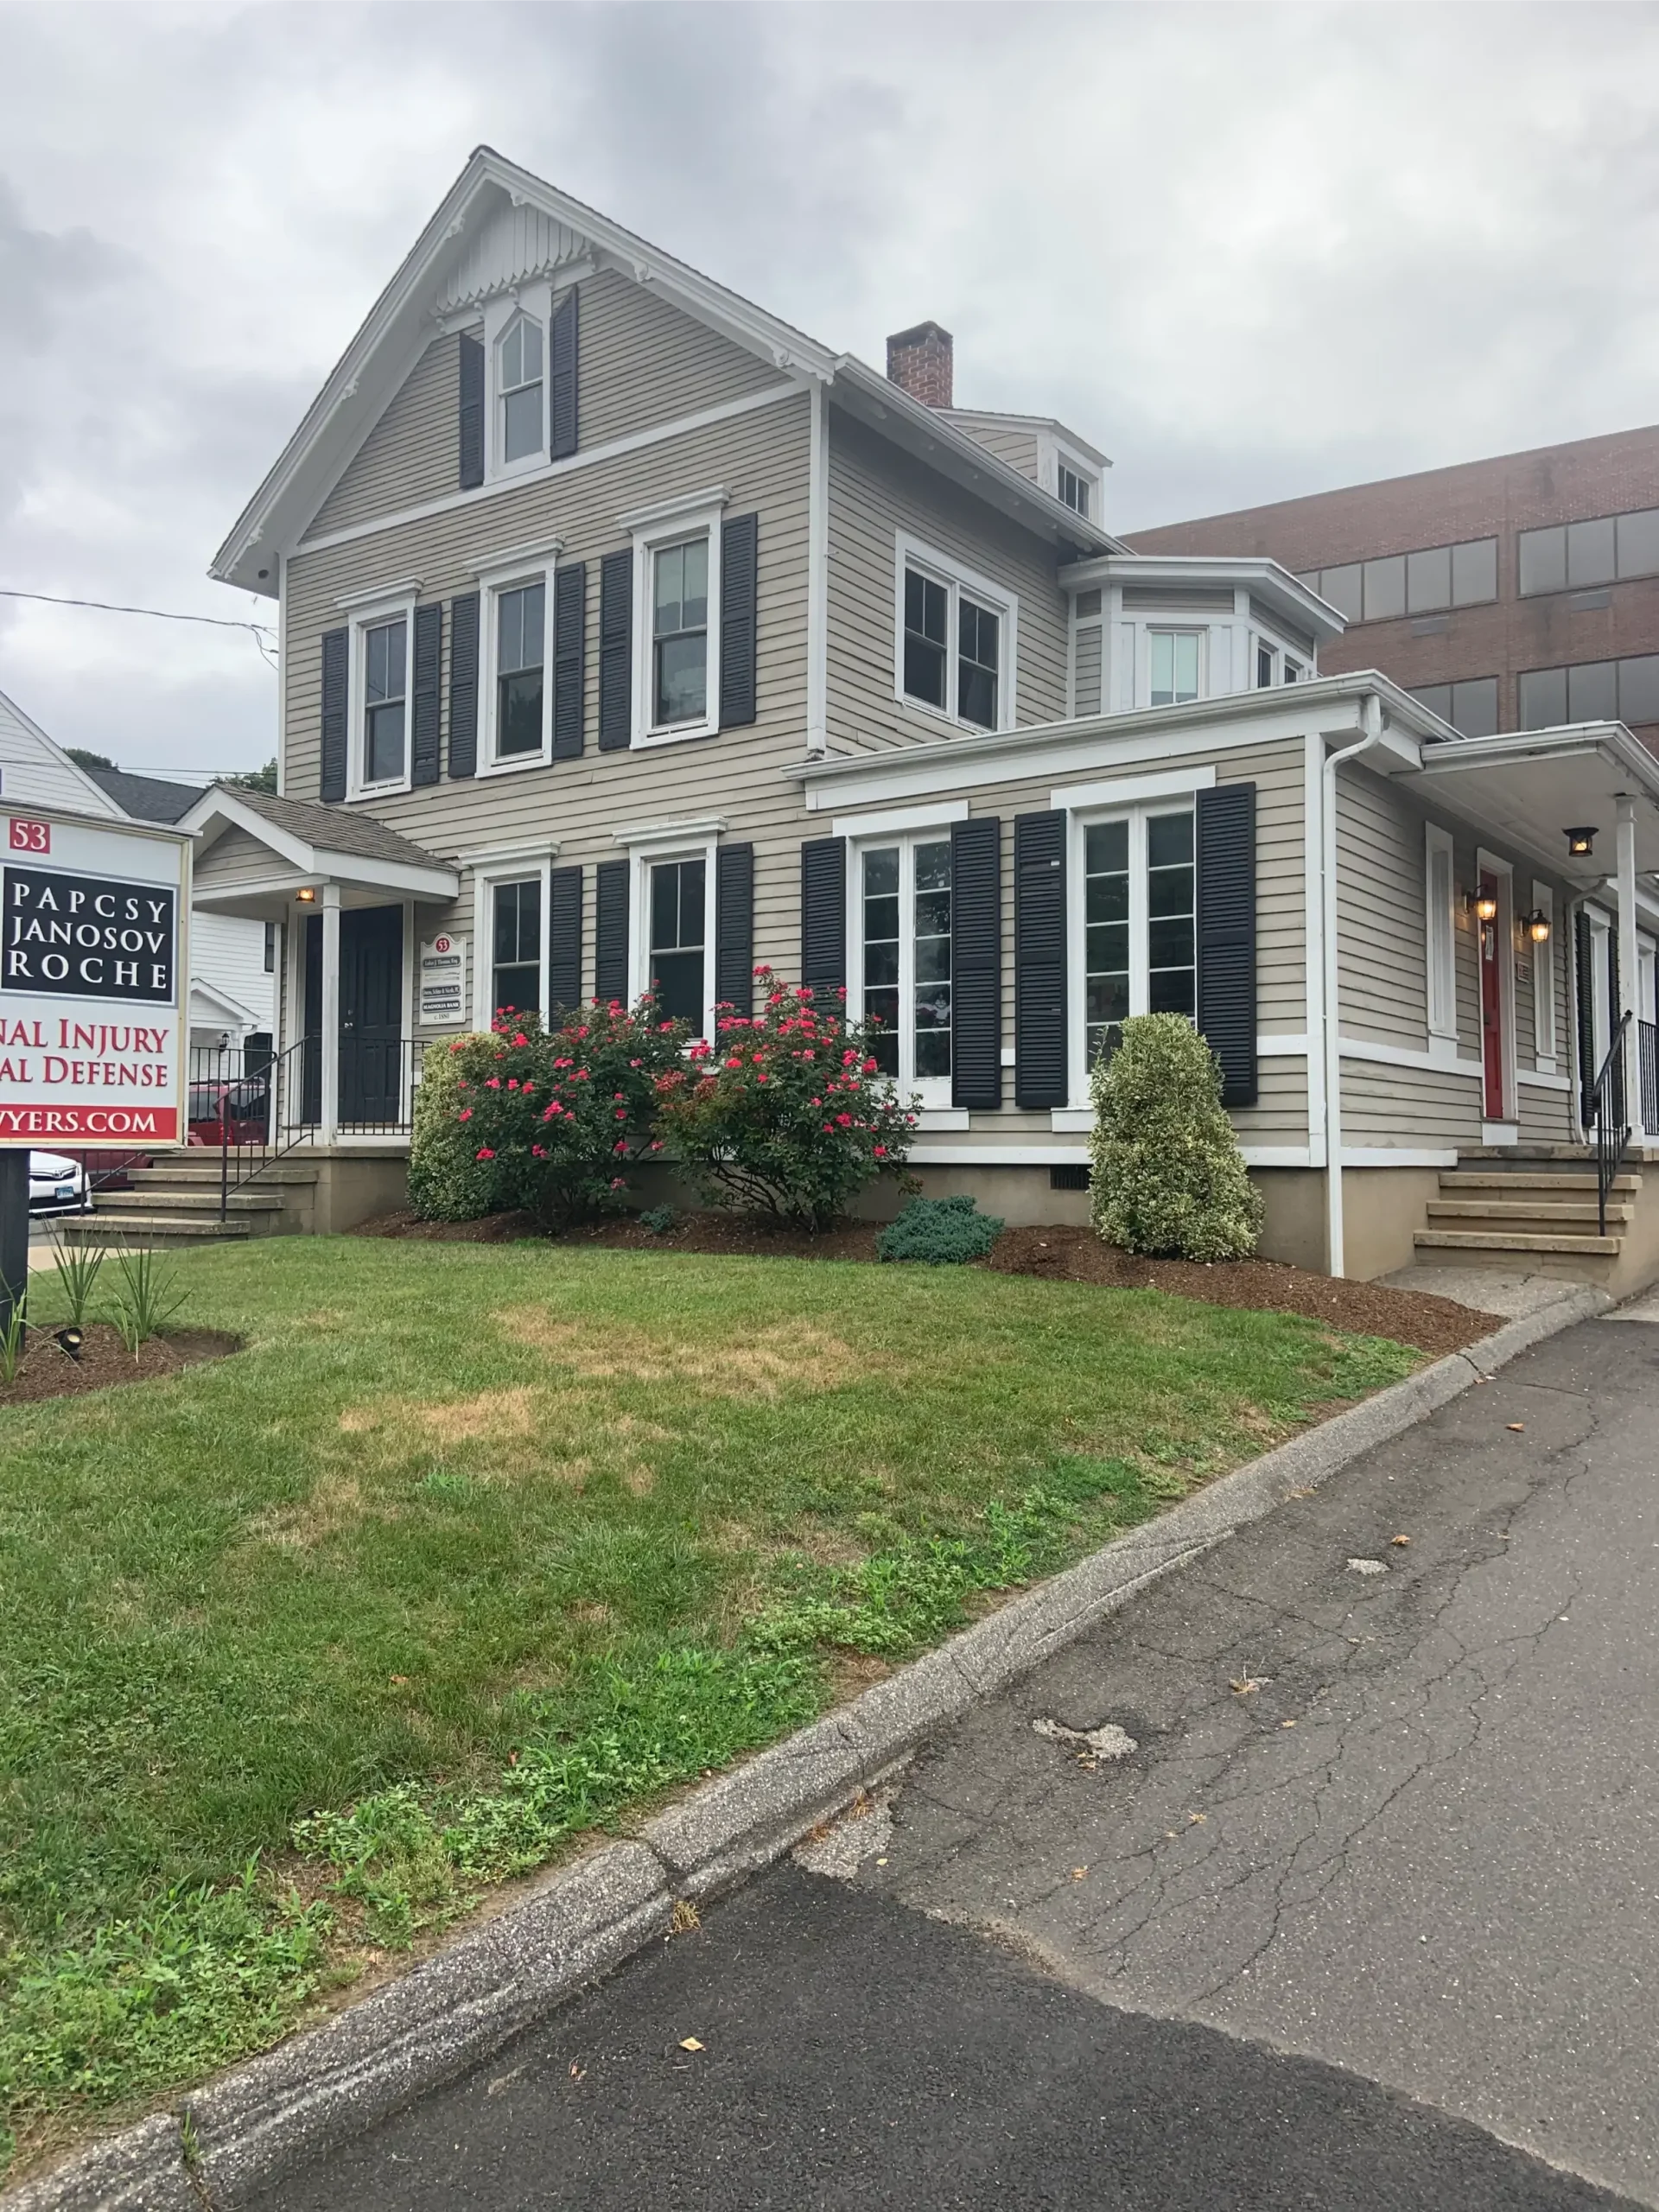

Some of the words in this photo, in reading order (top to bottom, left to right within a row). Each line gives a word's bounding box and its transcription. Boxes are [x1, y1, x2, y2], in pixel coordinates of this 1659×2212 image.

[13, 822, 47, 850] 53
[12, 882, 167, 924] PAPCSY
[10, 916, 166, 955] JANOSOV
[438, 939, 448, 951] 53
[7, 950, 167, 989] ROCHE
[0, 1109, 157, 1134] YERS.COM
